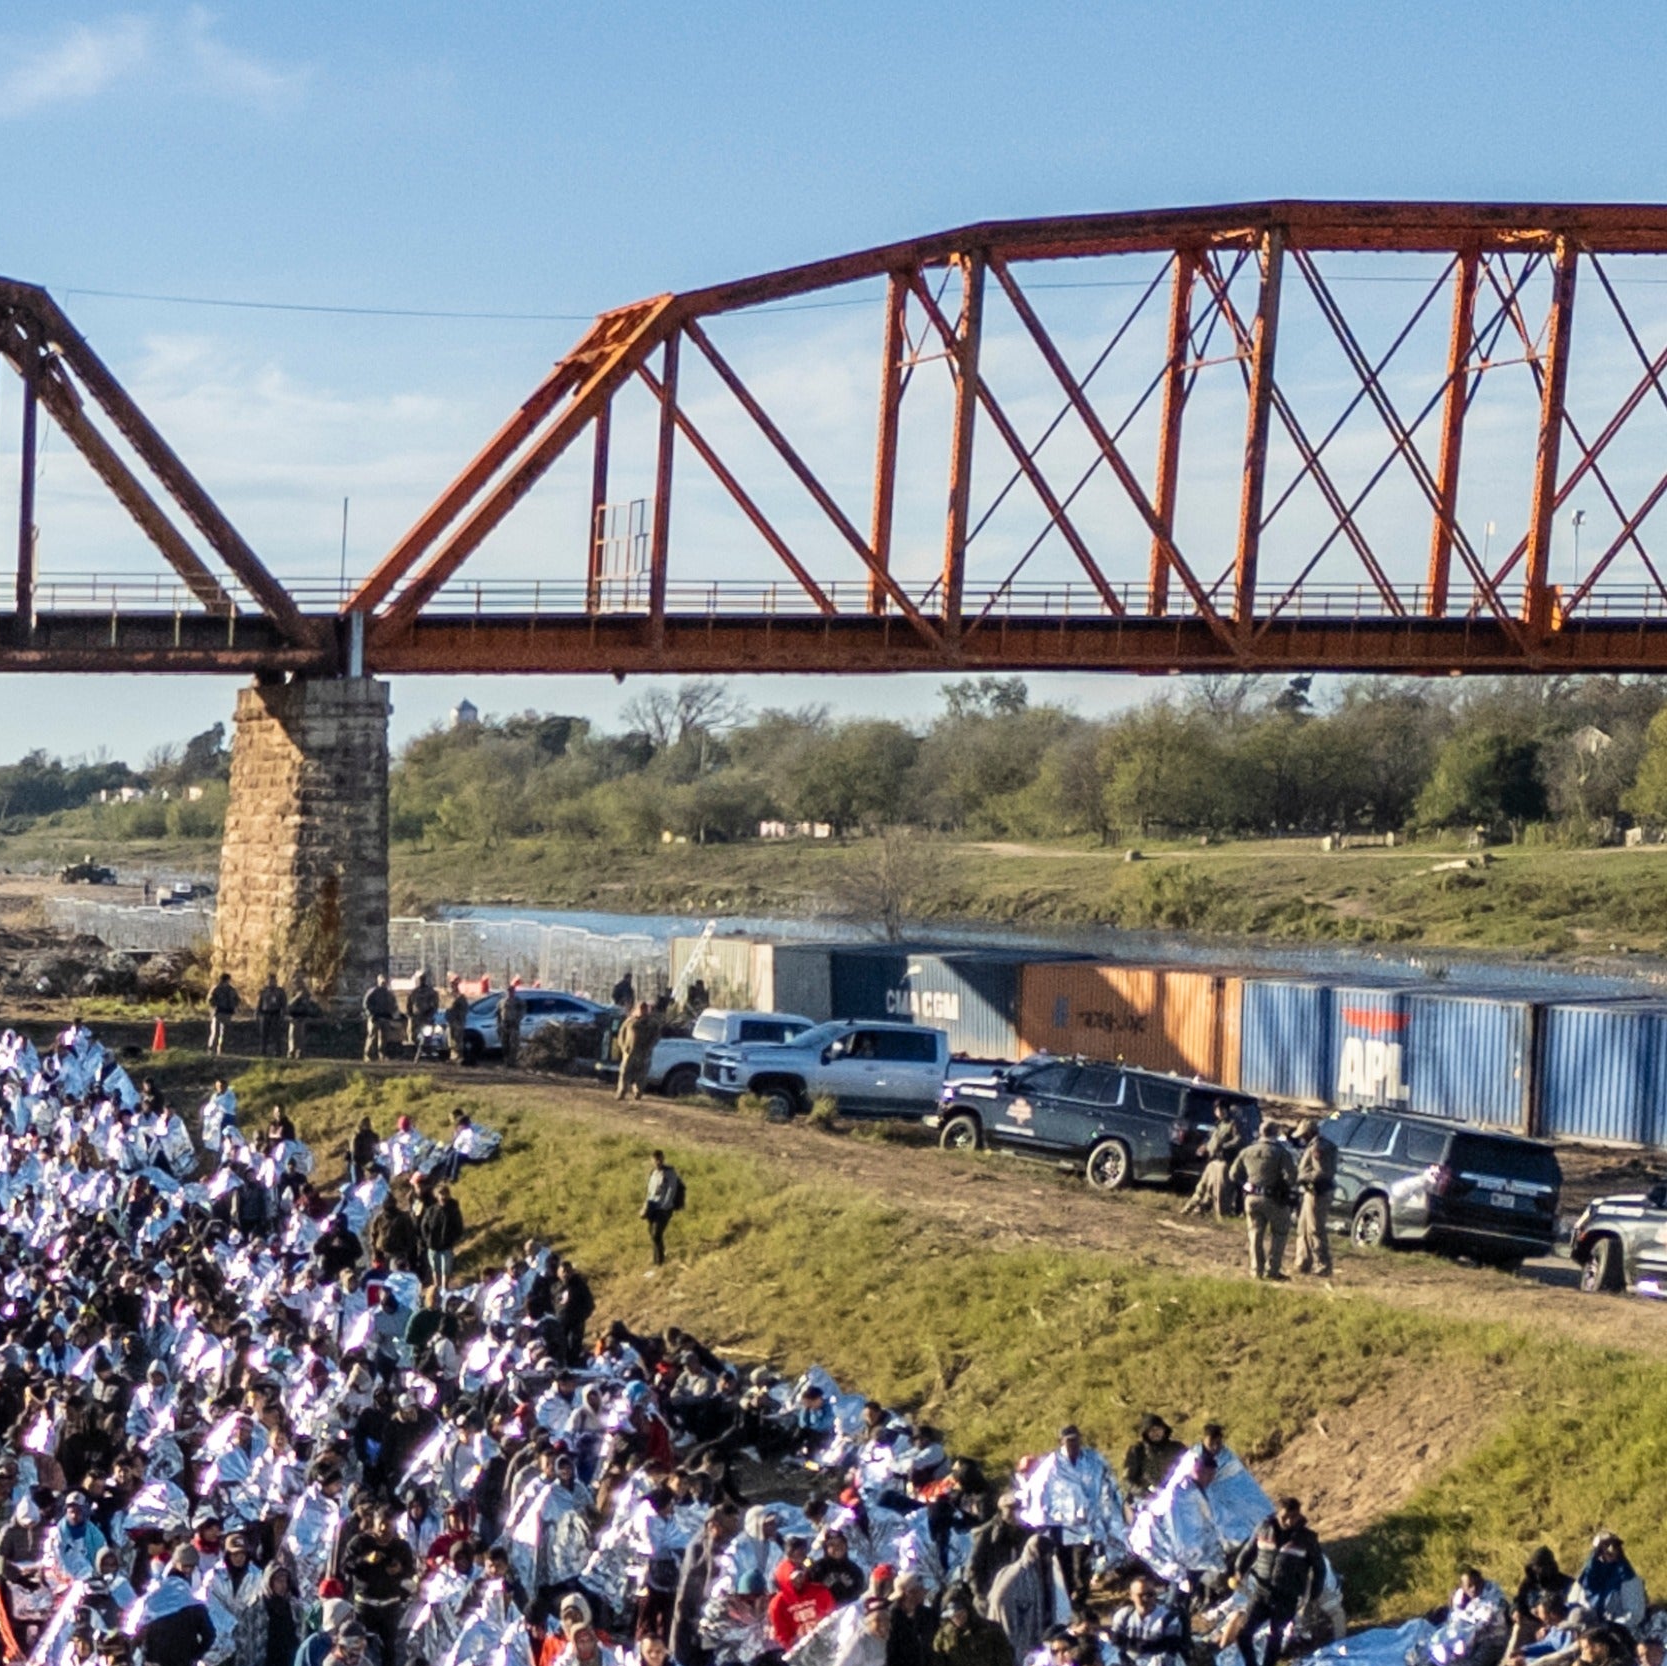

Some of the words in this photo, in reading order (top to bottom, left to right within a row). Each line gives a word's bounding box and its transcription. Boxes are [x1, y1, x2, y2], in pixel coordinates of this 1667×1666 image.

[886, 989, 919, 1015] CMA
[922, 991, 960, 1020] CGM
[1338, 1036, 1410, 1101] APL
